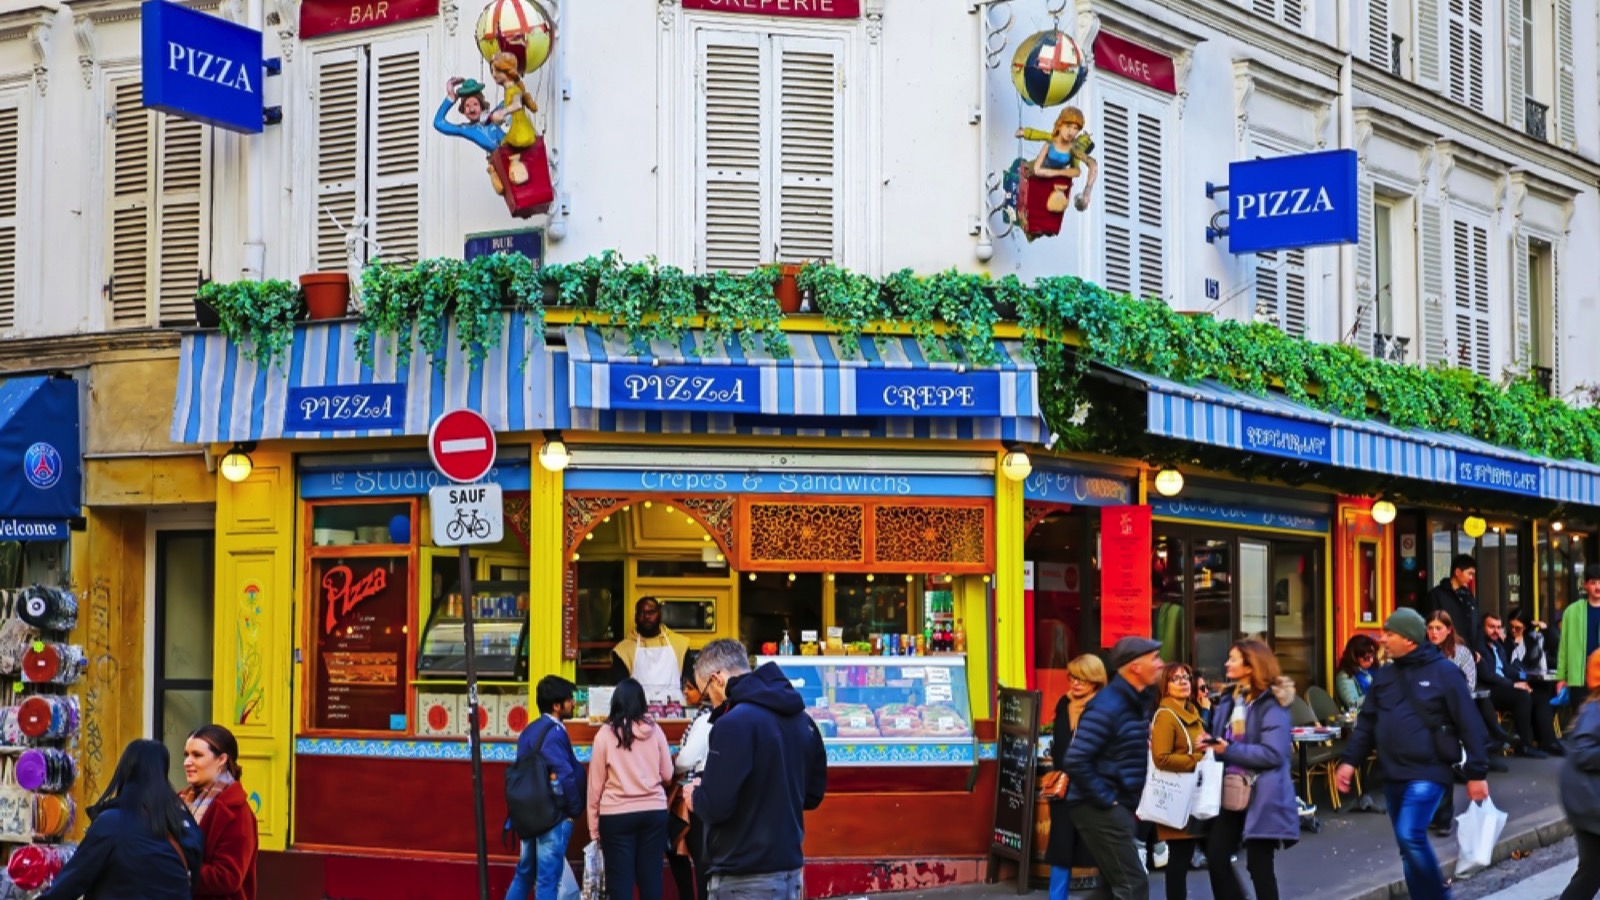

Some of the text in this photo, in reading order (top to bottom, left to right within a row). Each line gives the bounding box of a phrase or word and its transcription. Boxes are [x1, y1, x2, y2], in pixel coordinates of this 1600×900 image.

[350, 2, 389, 25] BAR
[167, 40, 254, 94] PIZZA
[1118, 52, 1151, 82] CAFE
[1236, 185, 1334, 220] PIZZA
[492, 236, 514, 250] RUE
[1207, 279, 1217, 298] 15
[624, 374, 745, 403] PIZZA
[883, 385, 975, 411] CREPE
[300, 395, 393, 420] PIZZA
[449, 489, 486, 504] SAUF
